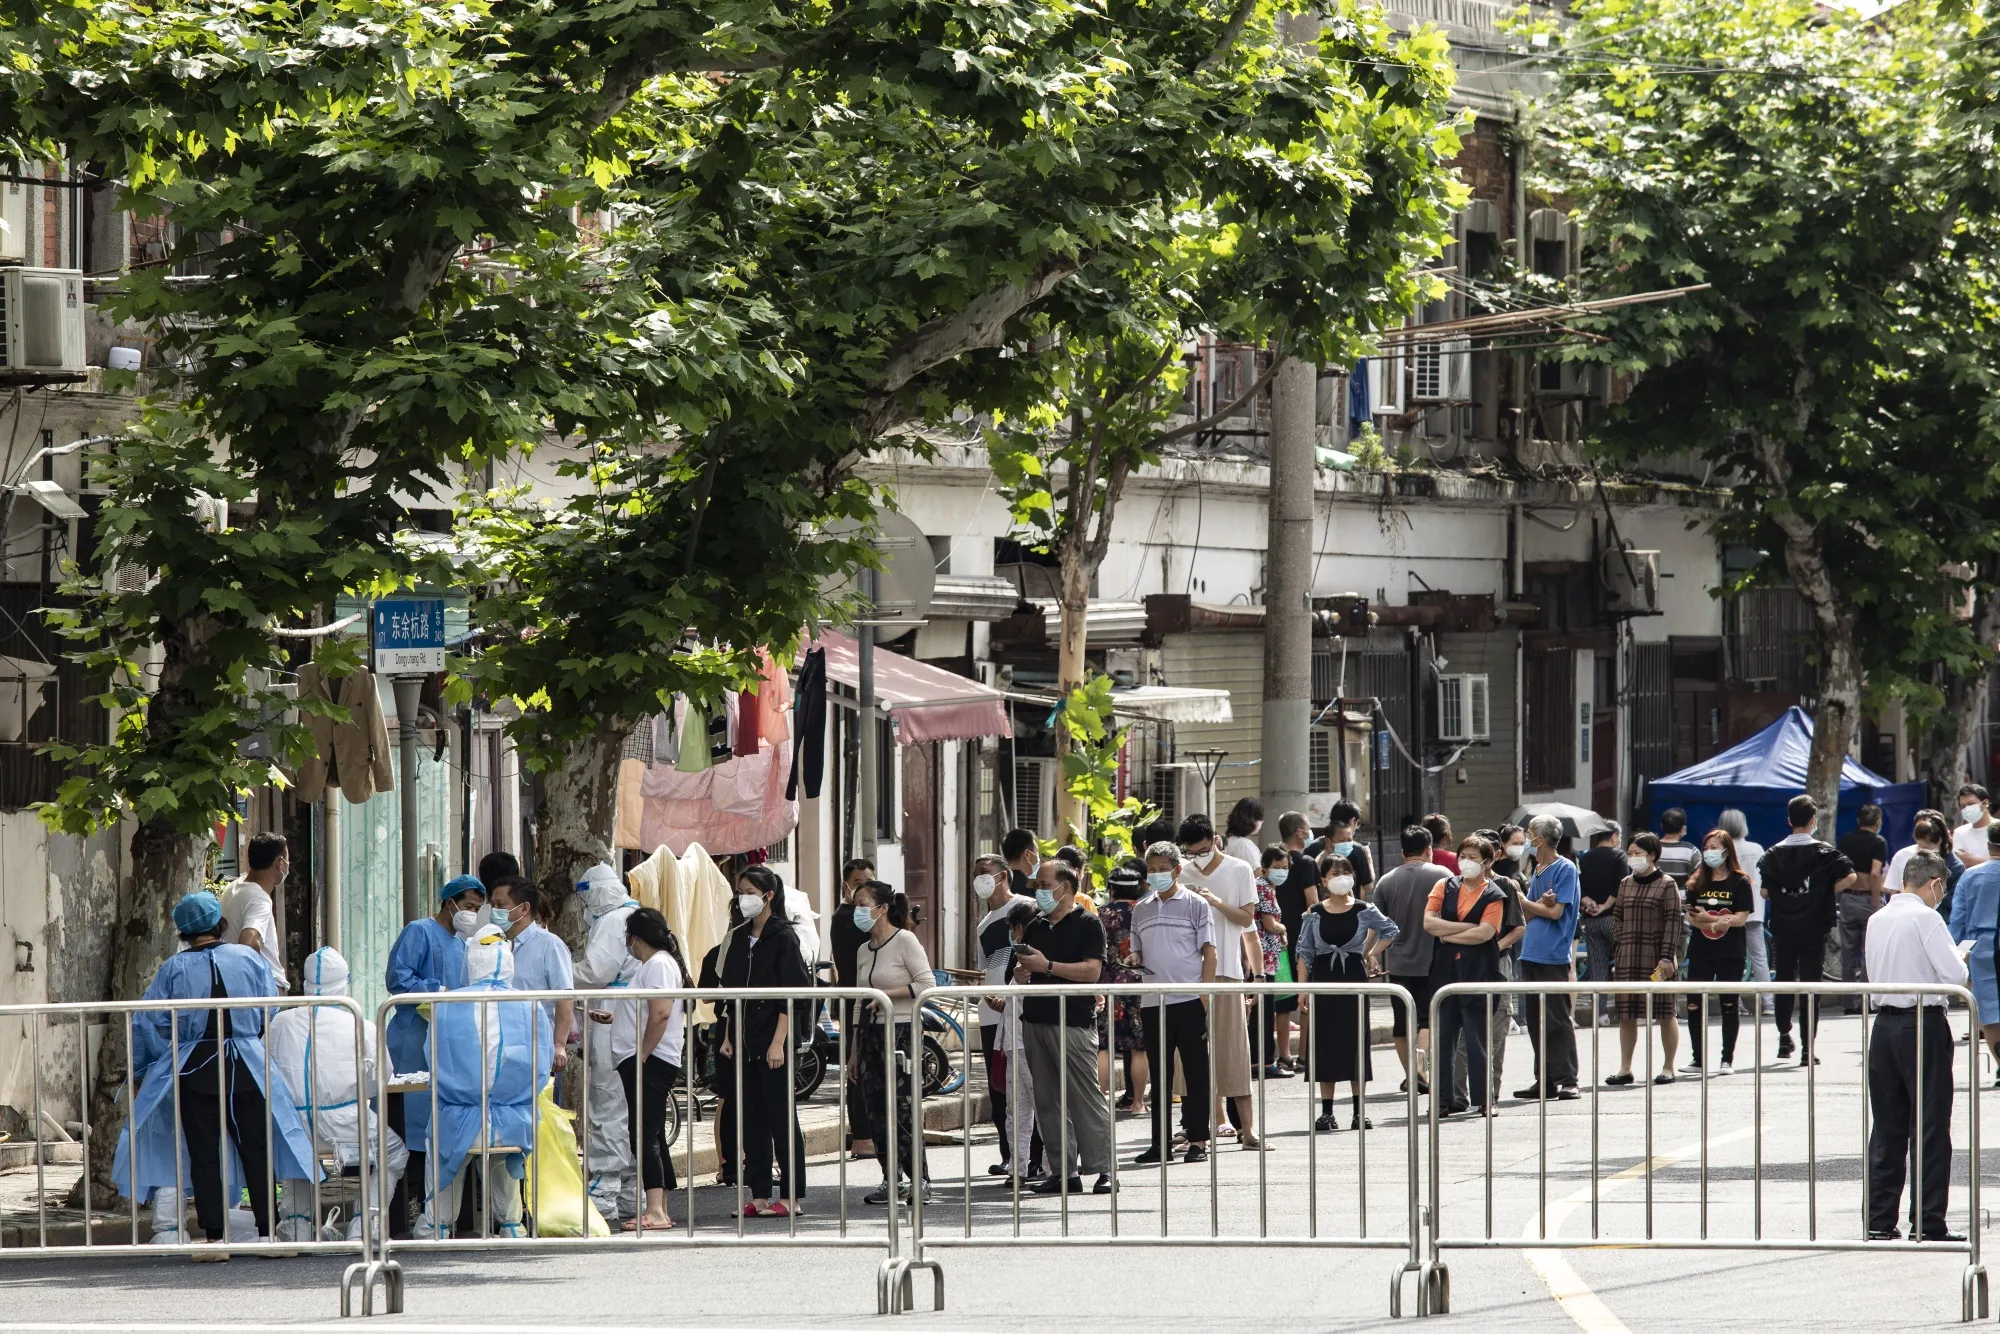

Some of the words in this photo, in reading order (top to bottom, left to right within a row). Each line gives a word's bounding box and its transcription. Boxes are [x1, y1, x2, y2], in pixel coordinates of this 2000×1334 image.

[391, 611, 430, 640] 东余杭路
[380, 653, 386, 668] W
[436, 652, 441, 667] E
